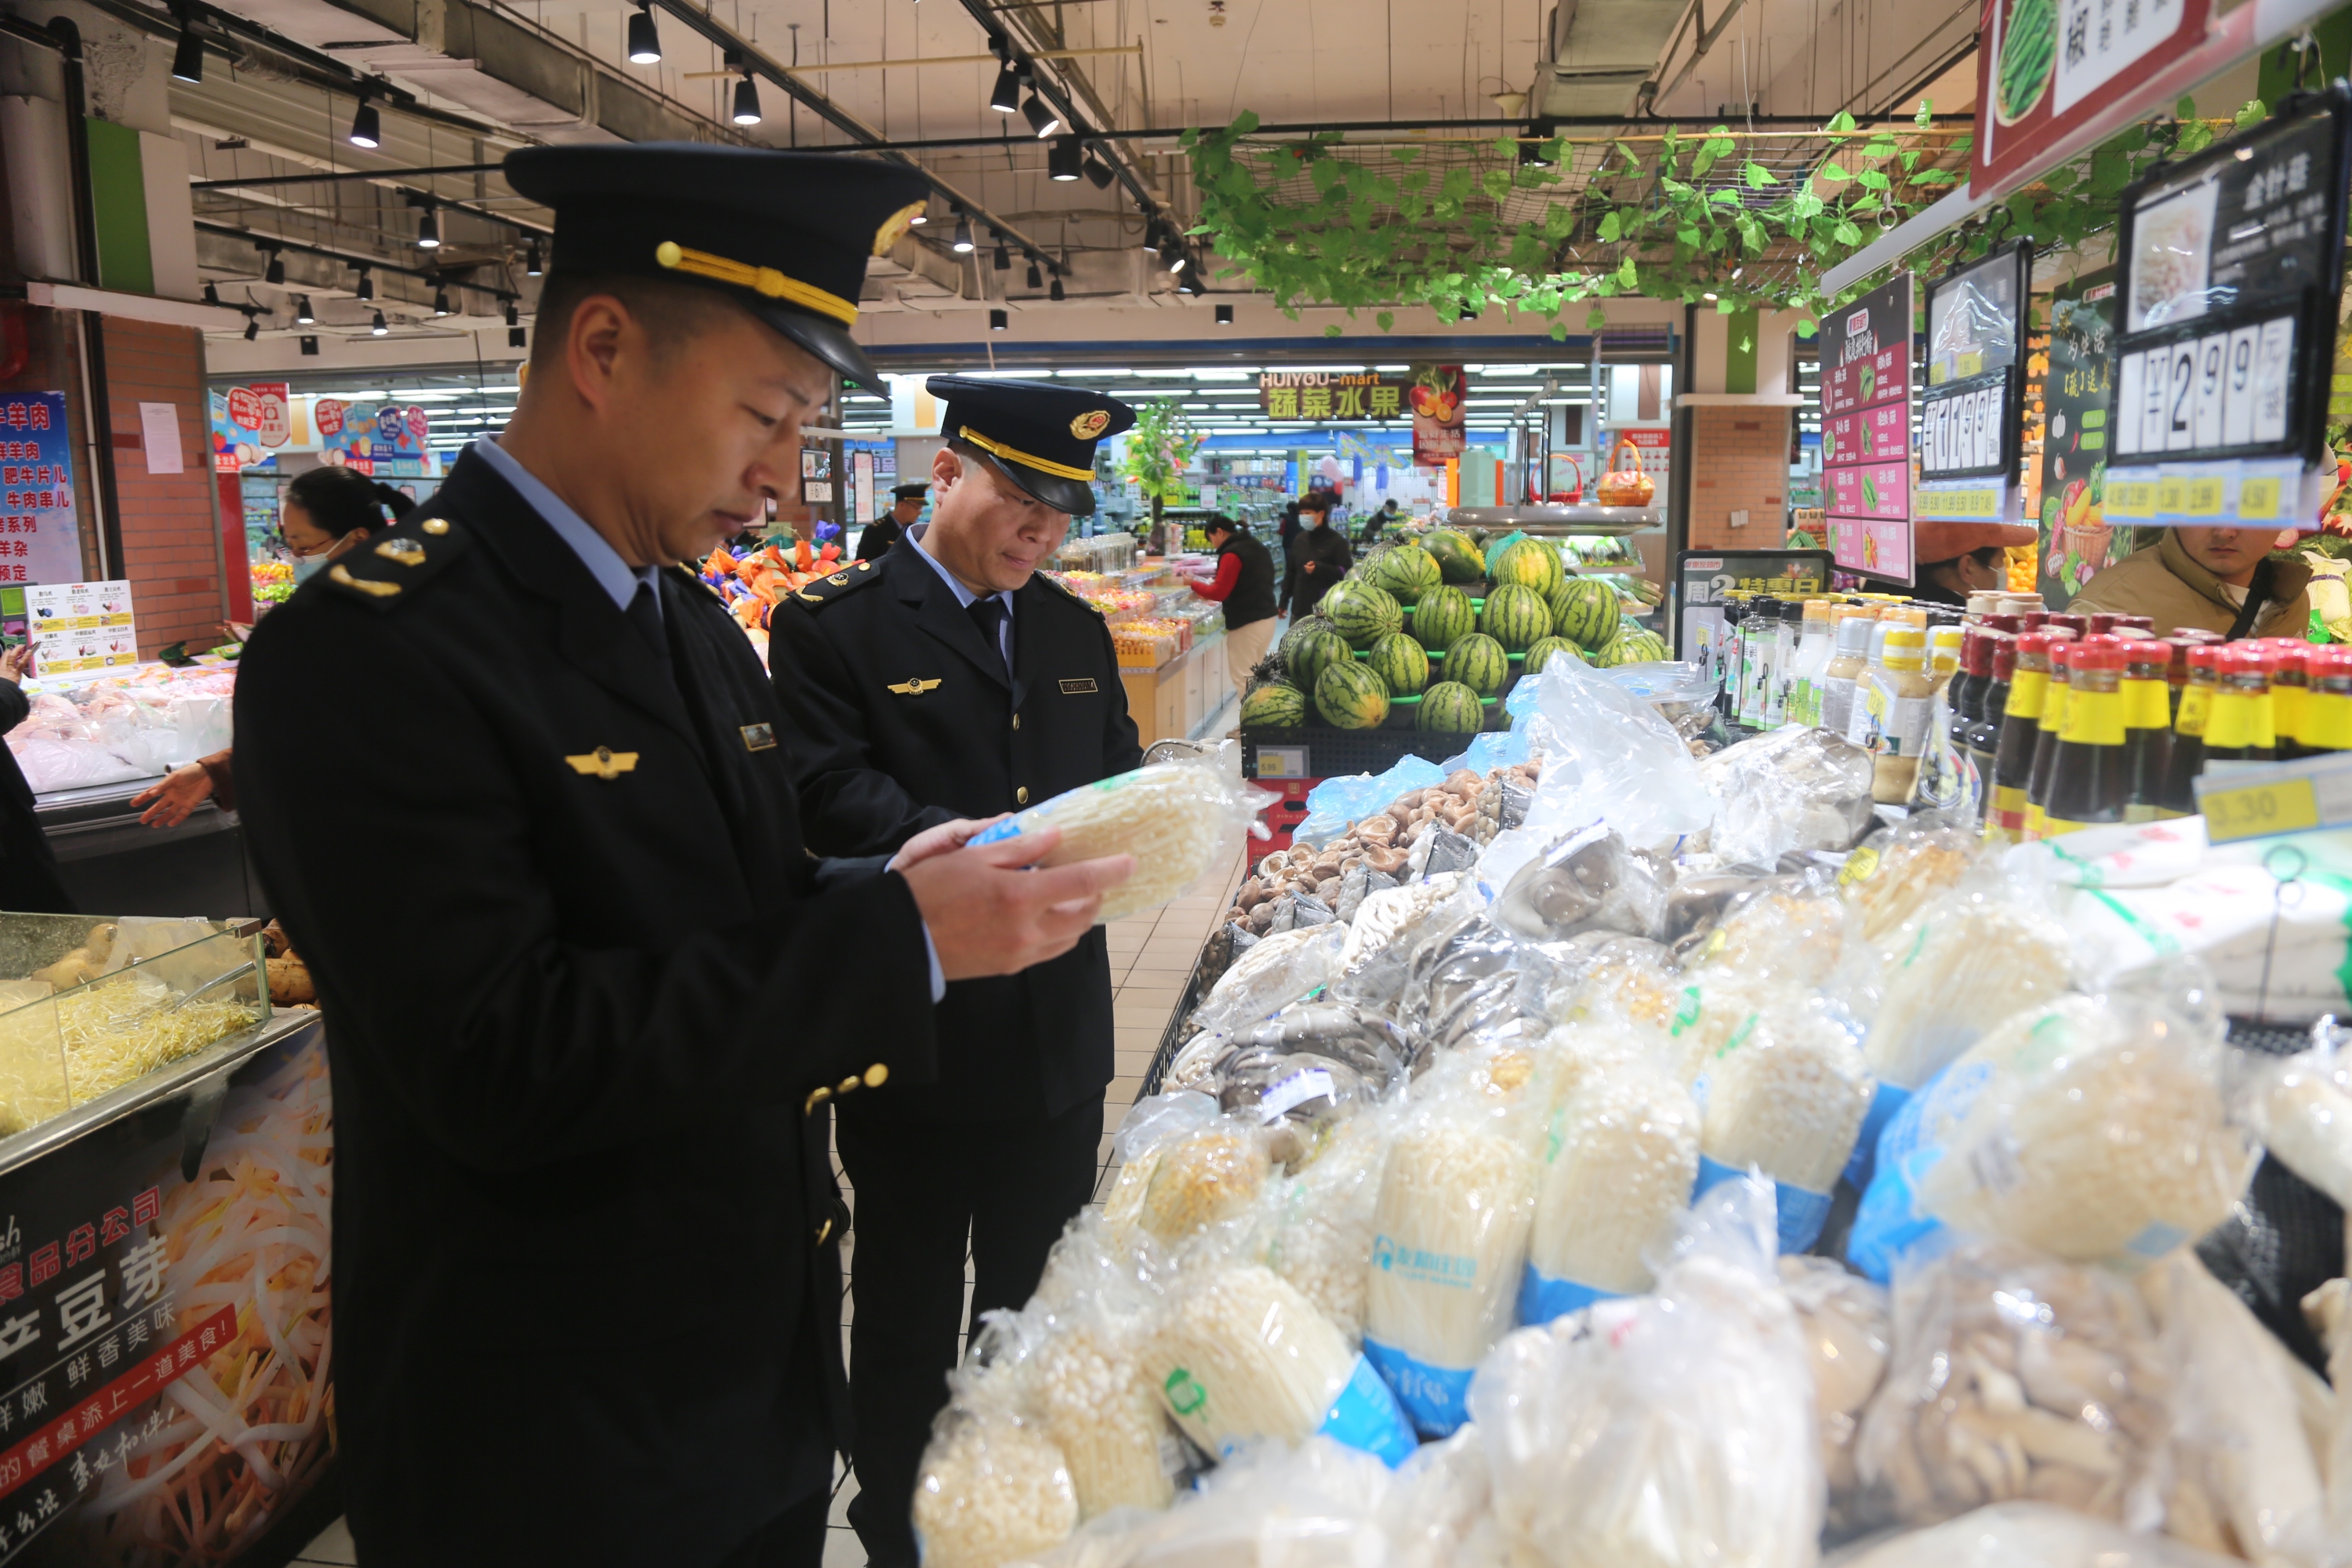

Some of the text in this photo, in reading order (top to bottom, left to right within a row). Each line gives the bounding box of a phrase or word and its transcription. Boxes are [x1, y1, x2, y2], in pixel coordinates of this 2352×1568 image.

[0, 402, 50, 430] 羊肉
[1269, 387, 1400, 418] 蔬菜水果
[4, 465, 67, 485] 肥牛片儿
[7, 491, 70, 510] 牛肉串儿
[0, 1185, 161, 1306] 食品分公司
[67, 1301, 176, 1388] 鲜香美味
